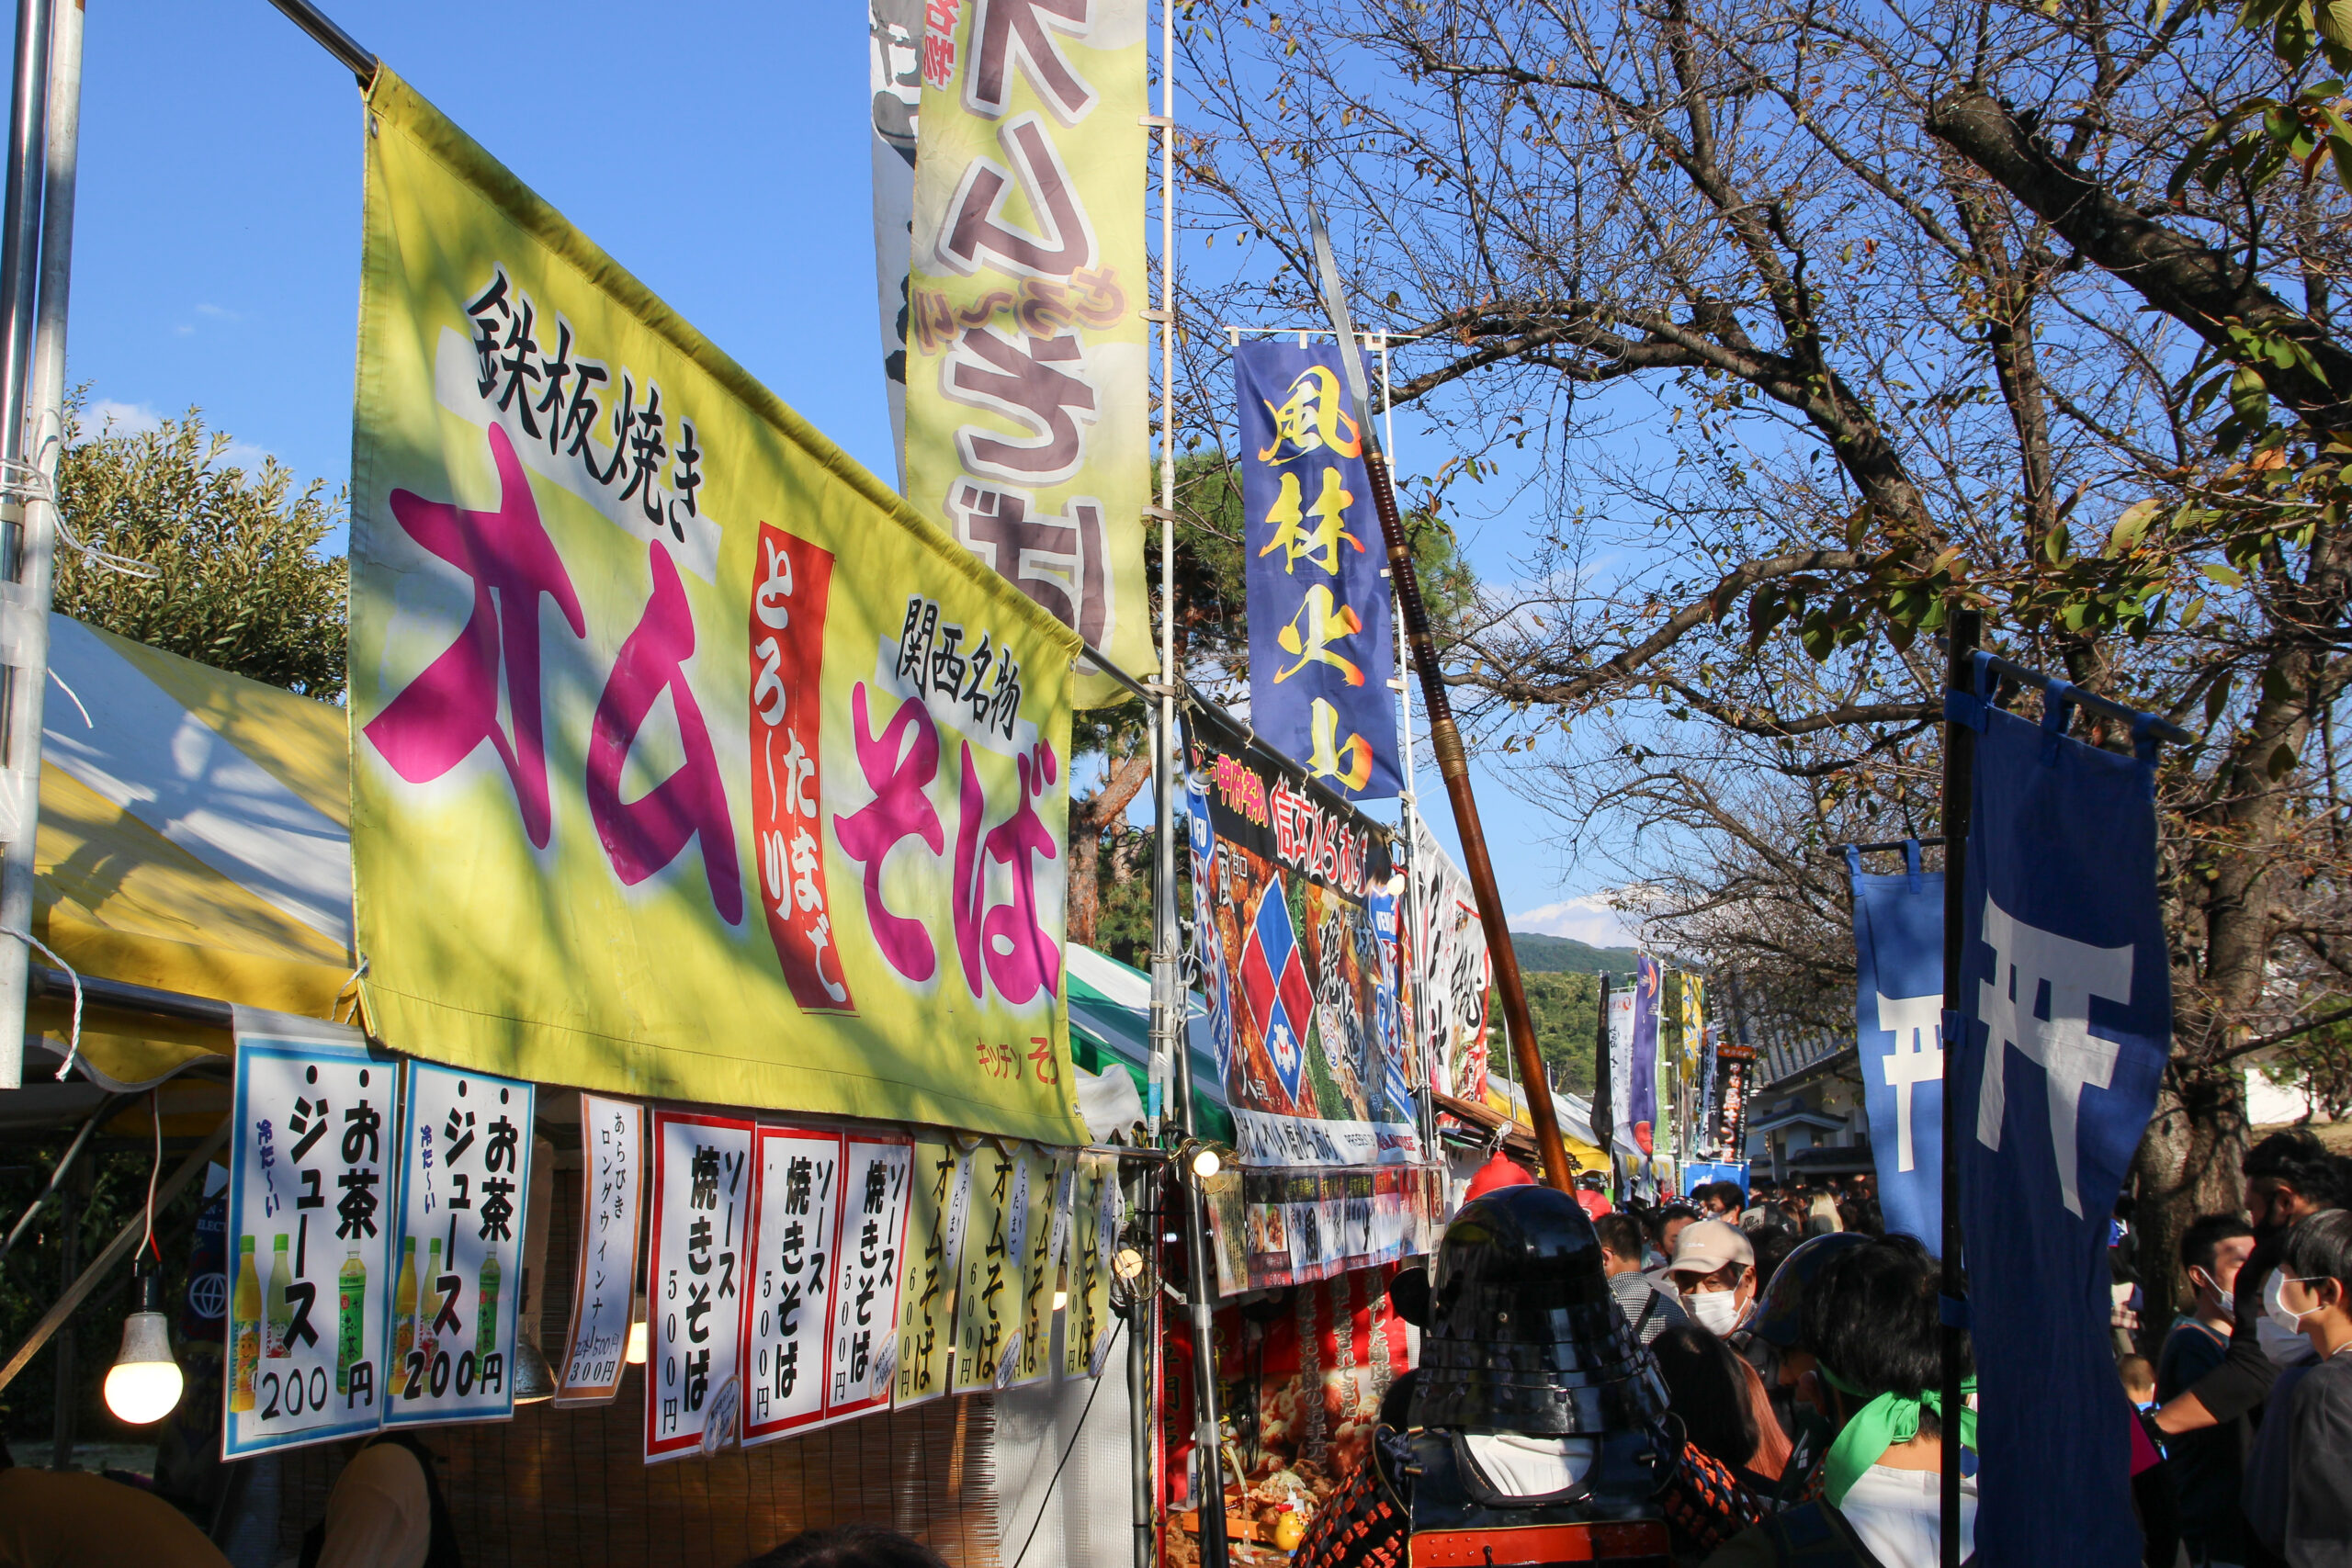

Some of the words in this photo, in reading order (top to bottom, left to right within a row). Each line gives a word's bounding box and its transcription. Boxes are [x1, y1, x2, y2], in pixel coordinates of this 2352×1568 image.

[467, 270, 699, 544] 鉄板焼き
[1258, 364, 1374, 792] 風林火山
[895, 595, 1023, 742] 関西名物
[284, 1096, 329, 1353] ジュース
[432, 1107, 475, 1337] ジュース
[613, 1111, 627, 1220] あらびき
[717, 1149, 746, 1300] ソース
[808, 1158, 834, 1296] ソース
[878, 1162, 907, 1288] ソース
[684, 1145, 720, 1413] 焼きそば
[775, 1155, 813, 1400] 焼きそば
[834, 1264, 853, 1401] 500円
[850, 1159, 887, 1383] 焼きそば
[901, 1267, 917, 1399] 600円
[914, 1145, 956, 1391] オムそば
[960, 1262, 978, 1385] 600円
[977, 1155, 1013, 1381] オムそば
[1068, 1265, 1080, 1374] 600円
[260, 1360, 375, 1421] 200円
[403, 1349, 503, 1401] 200円
[570, 1360, 616, 1382] 300円
[661, 1269, 678, 1435] 500円
[755, 1270, 772, 1420] 500円
